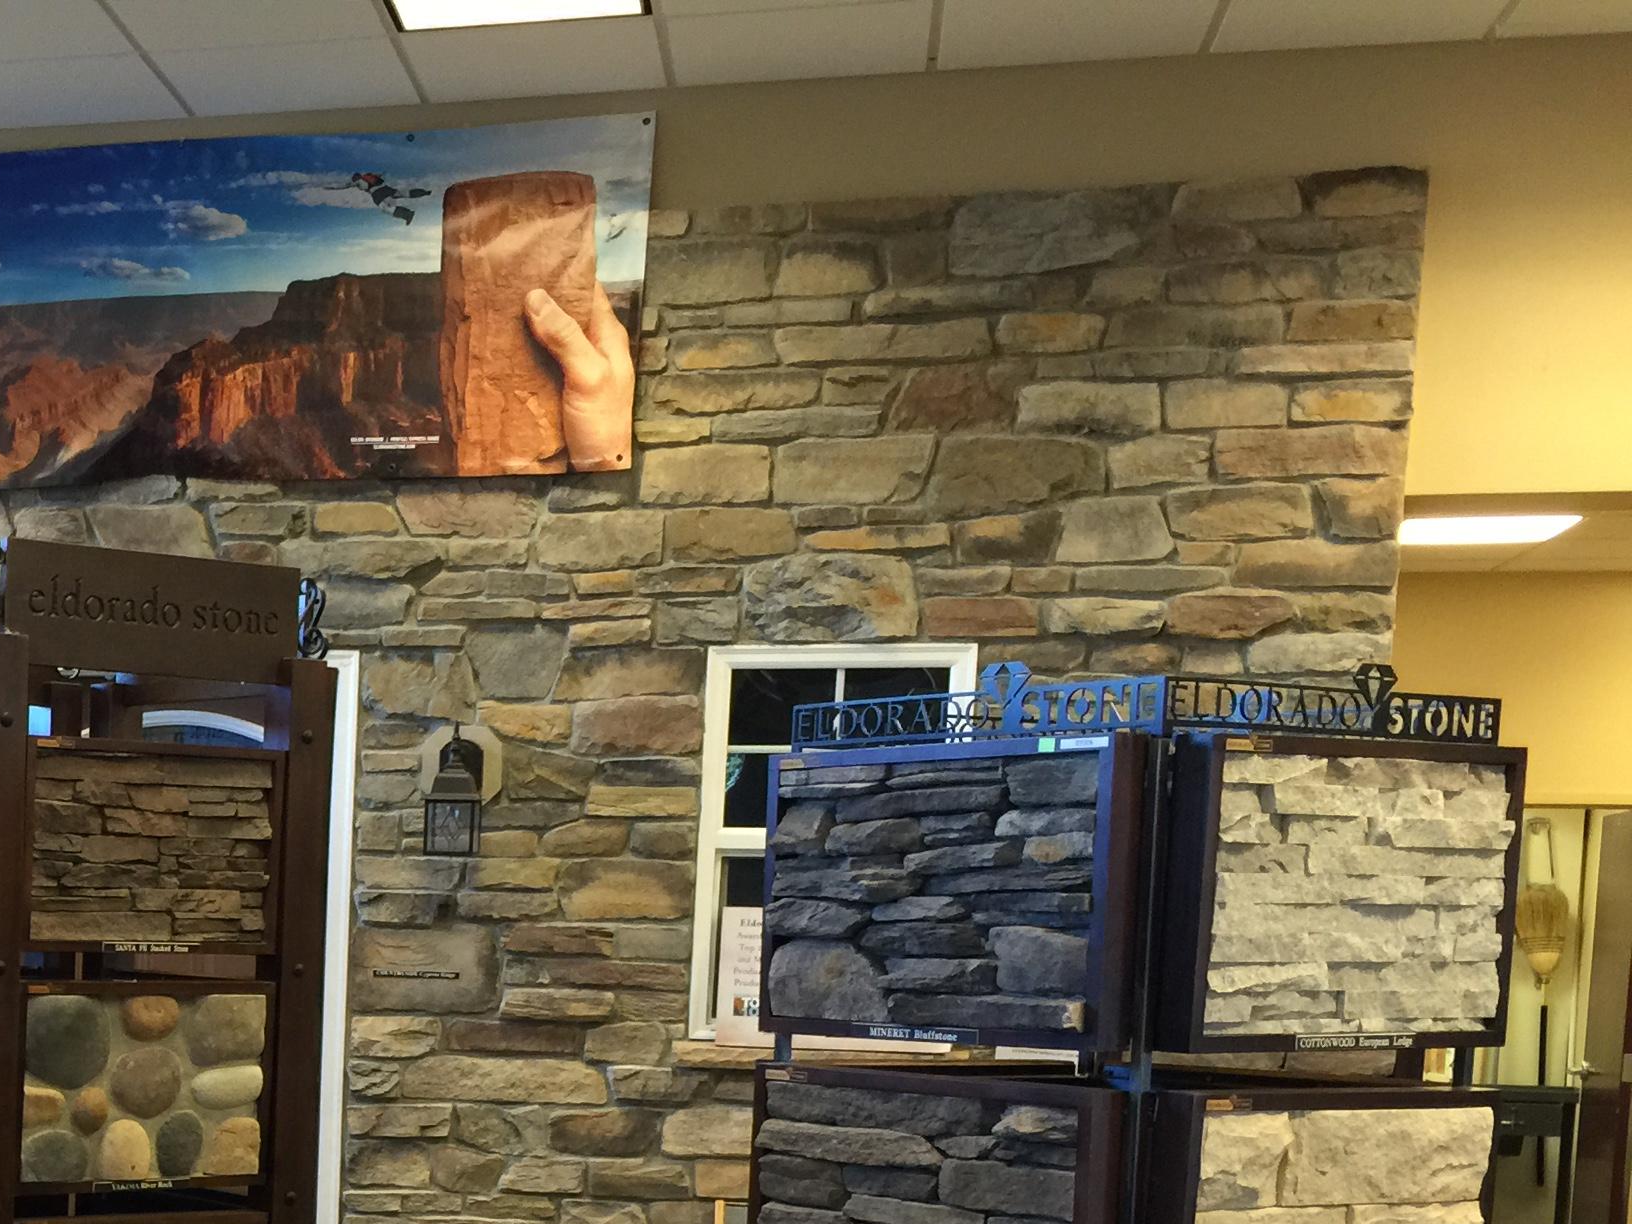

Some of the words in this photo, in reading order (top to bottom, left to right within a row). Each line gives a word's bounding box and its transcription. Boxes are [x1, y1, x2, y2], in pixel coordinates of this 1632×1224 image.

[28, 574, 182, 630] eldorado
[191, 601, 280, 636] stone
[797, 698, 990, 742] ELDORADO
[1021, 681, 1157, 729] STONE
[1169, 679, 1362, 730] ELDORADO
[1386, 697, 1494, 740] STONE
[869, 1026, 912, 1039] MINERET
[913, 1029, 958, 1042] Bluffstone
[1299, 1036, 1356, 1048] COTTONWOOD
[1358, 1036, 1390, 1048] European
[1392, 1036, 1414, 1047] Ledge
